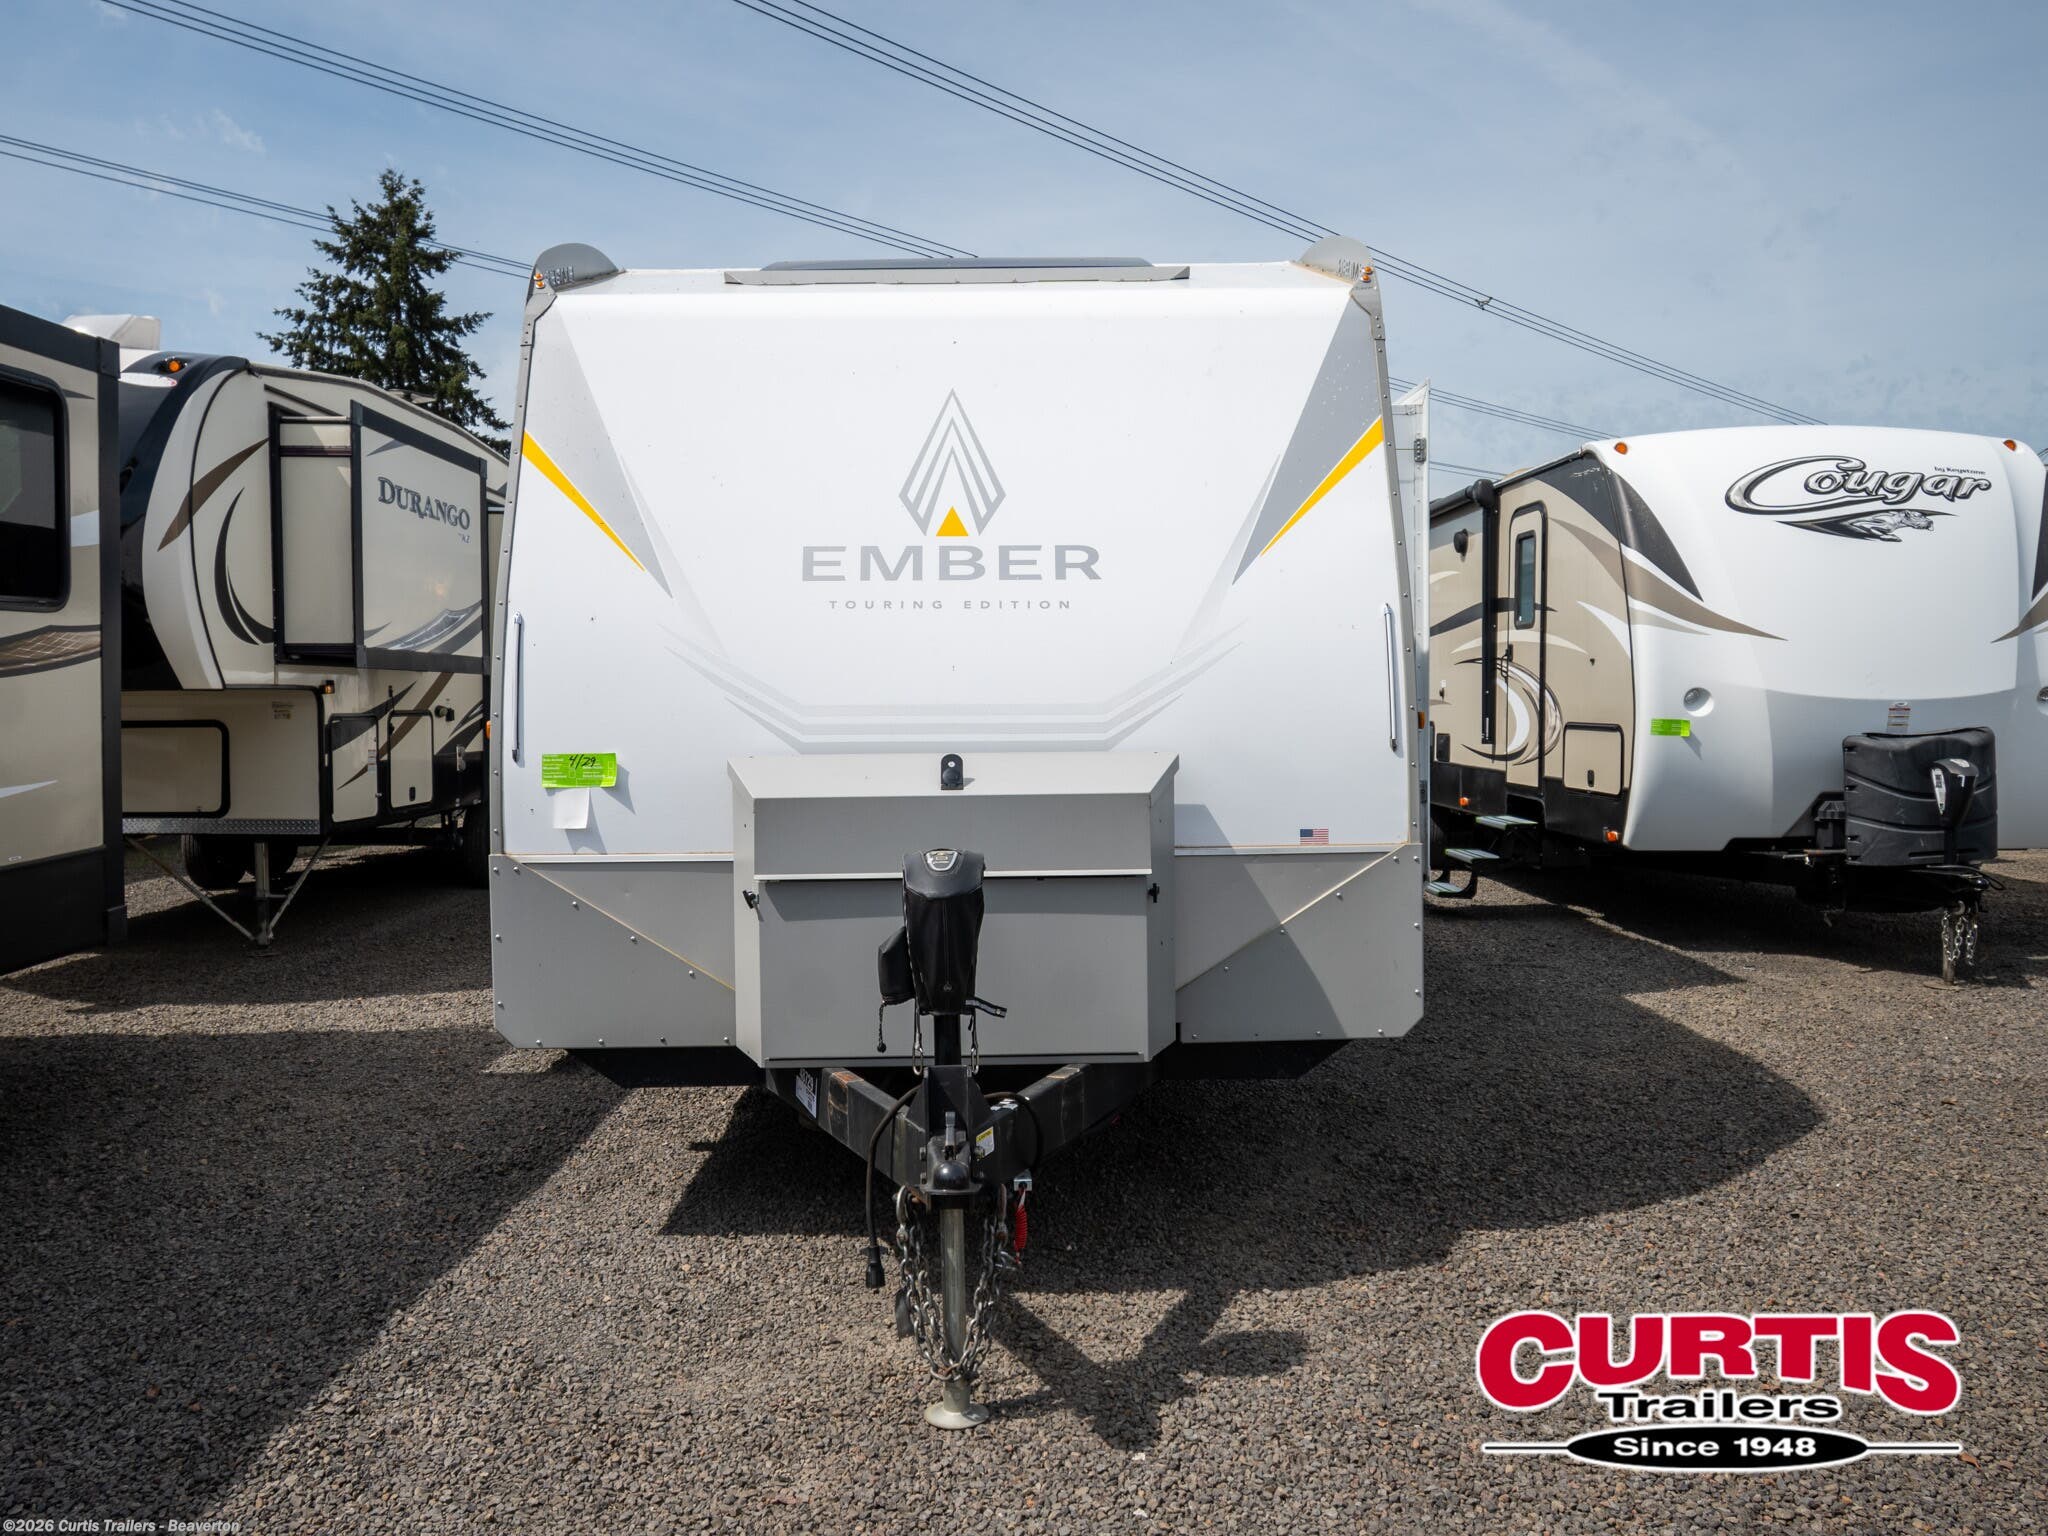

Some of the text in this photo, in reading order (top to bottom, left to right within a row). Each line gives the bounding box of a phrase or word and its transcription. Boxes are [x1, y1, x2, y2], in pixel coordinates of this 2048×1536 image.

[377, 476, 470, 531] DURANGO
[1724, 455, 1992, 515] Cougar
[801, 545, 1103, 582] EMBER
[829, 600, 1071, 610] TOURING EDITION
[568, 753, 597, 770] 4/29
